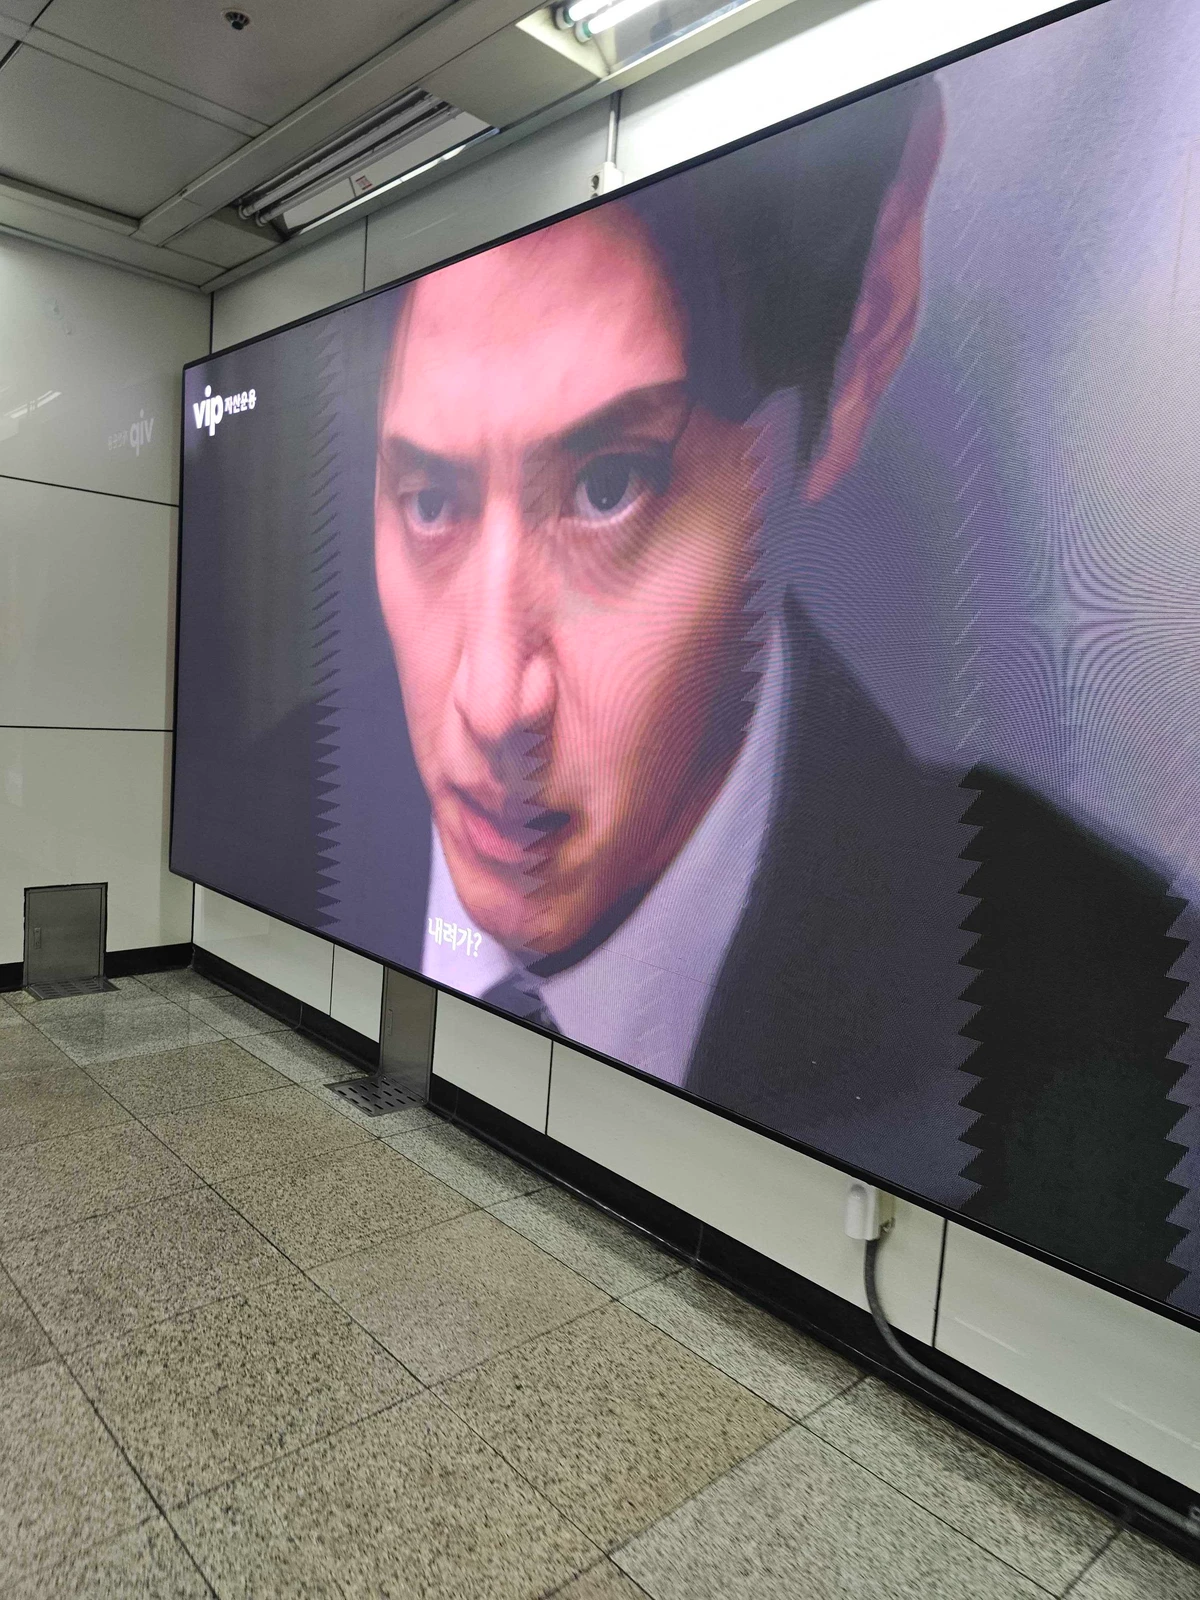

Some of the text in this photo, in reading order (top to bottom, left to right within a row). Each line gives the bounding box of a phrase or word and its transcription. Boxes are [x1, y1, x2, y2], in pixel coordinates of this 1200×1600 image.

[193, 385, 257, 436] vip 자산운용
[427, 917, 482, 957] 내려가?
